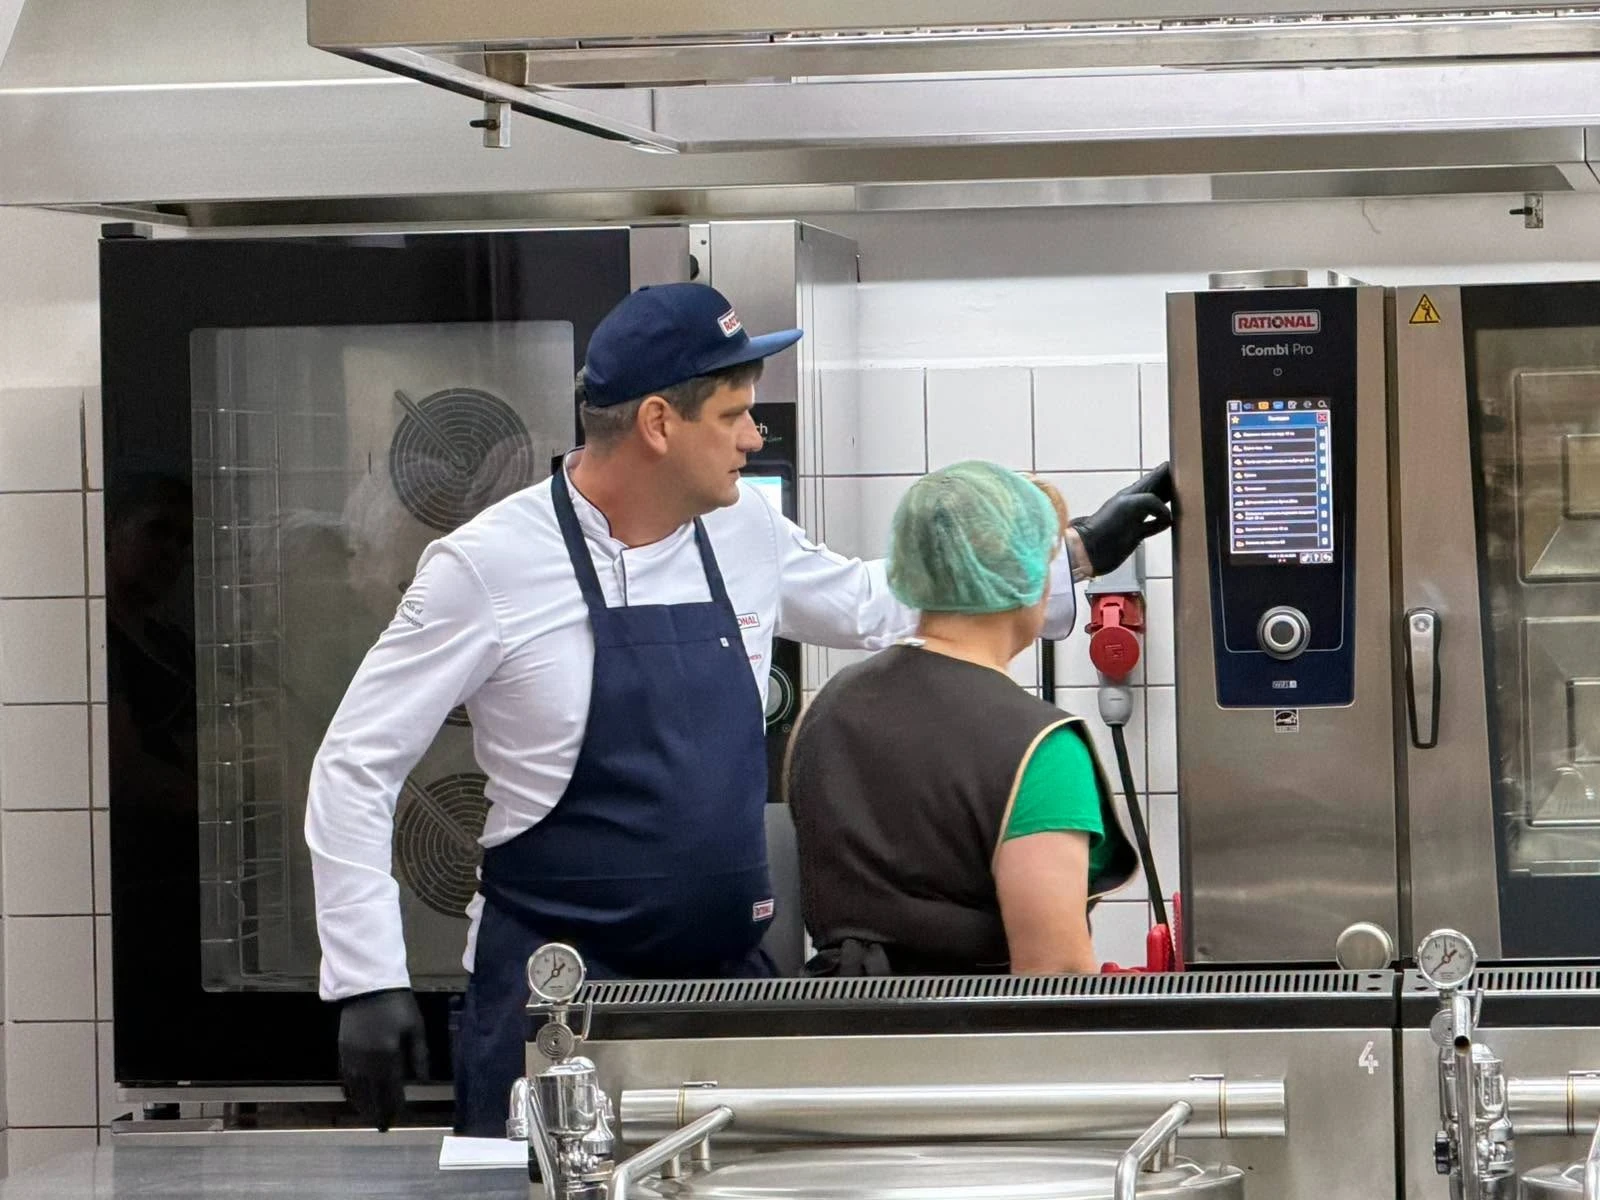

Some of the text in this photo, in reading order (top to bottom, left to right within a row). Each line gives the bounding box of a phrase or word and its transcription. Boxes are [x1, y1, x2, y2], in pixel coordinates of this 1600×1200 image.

[1238, 315, 1315, 330] RATIONAL
[1241, 343, 1314, 357] iCombi Pro
[1359, 1041, 1379, 1074] 4
